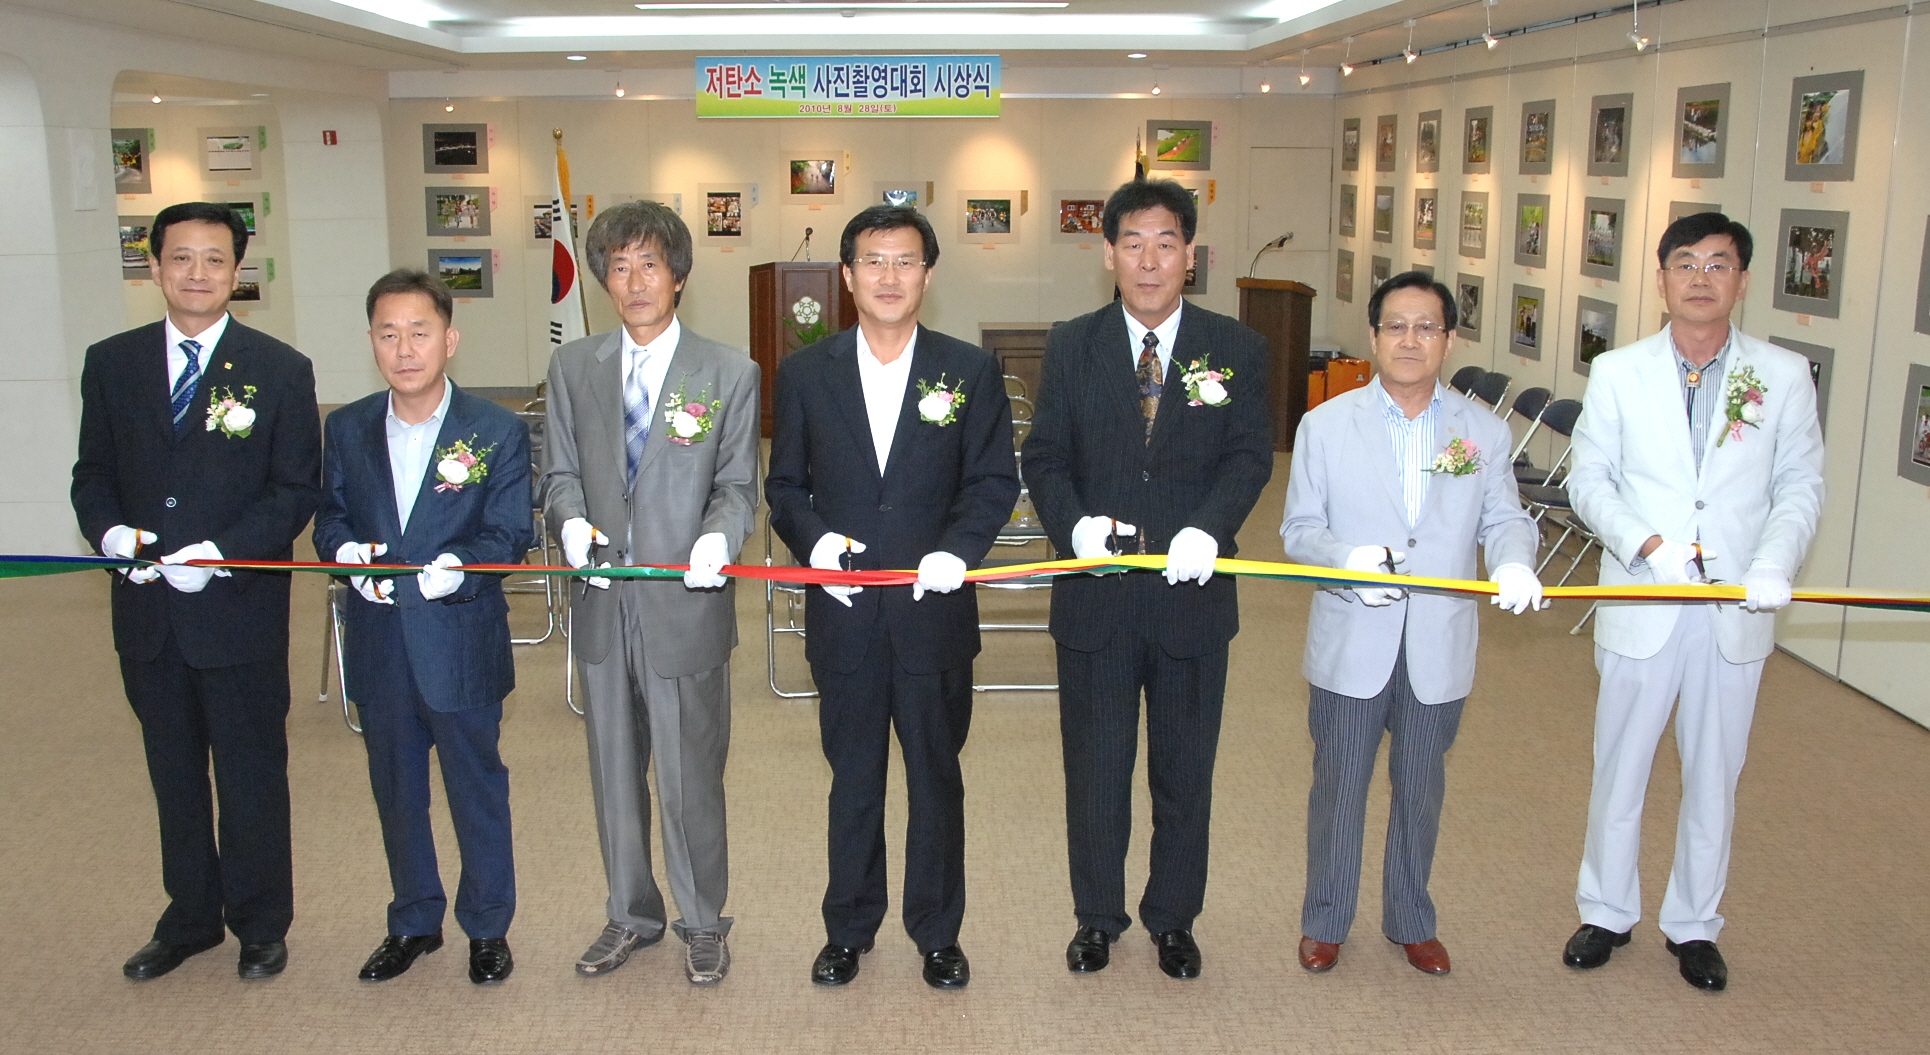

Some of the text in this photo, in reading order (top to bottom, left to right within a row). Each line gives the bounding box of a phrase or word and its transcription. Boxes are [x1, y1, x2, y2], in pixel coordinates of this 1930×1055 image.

[705, 63, 991, 99] 저탄소 녹색 사진촬영대회 시상식
[799, 103, 898, 114] 2010년 8월 28일(토)
